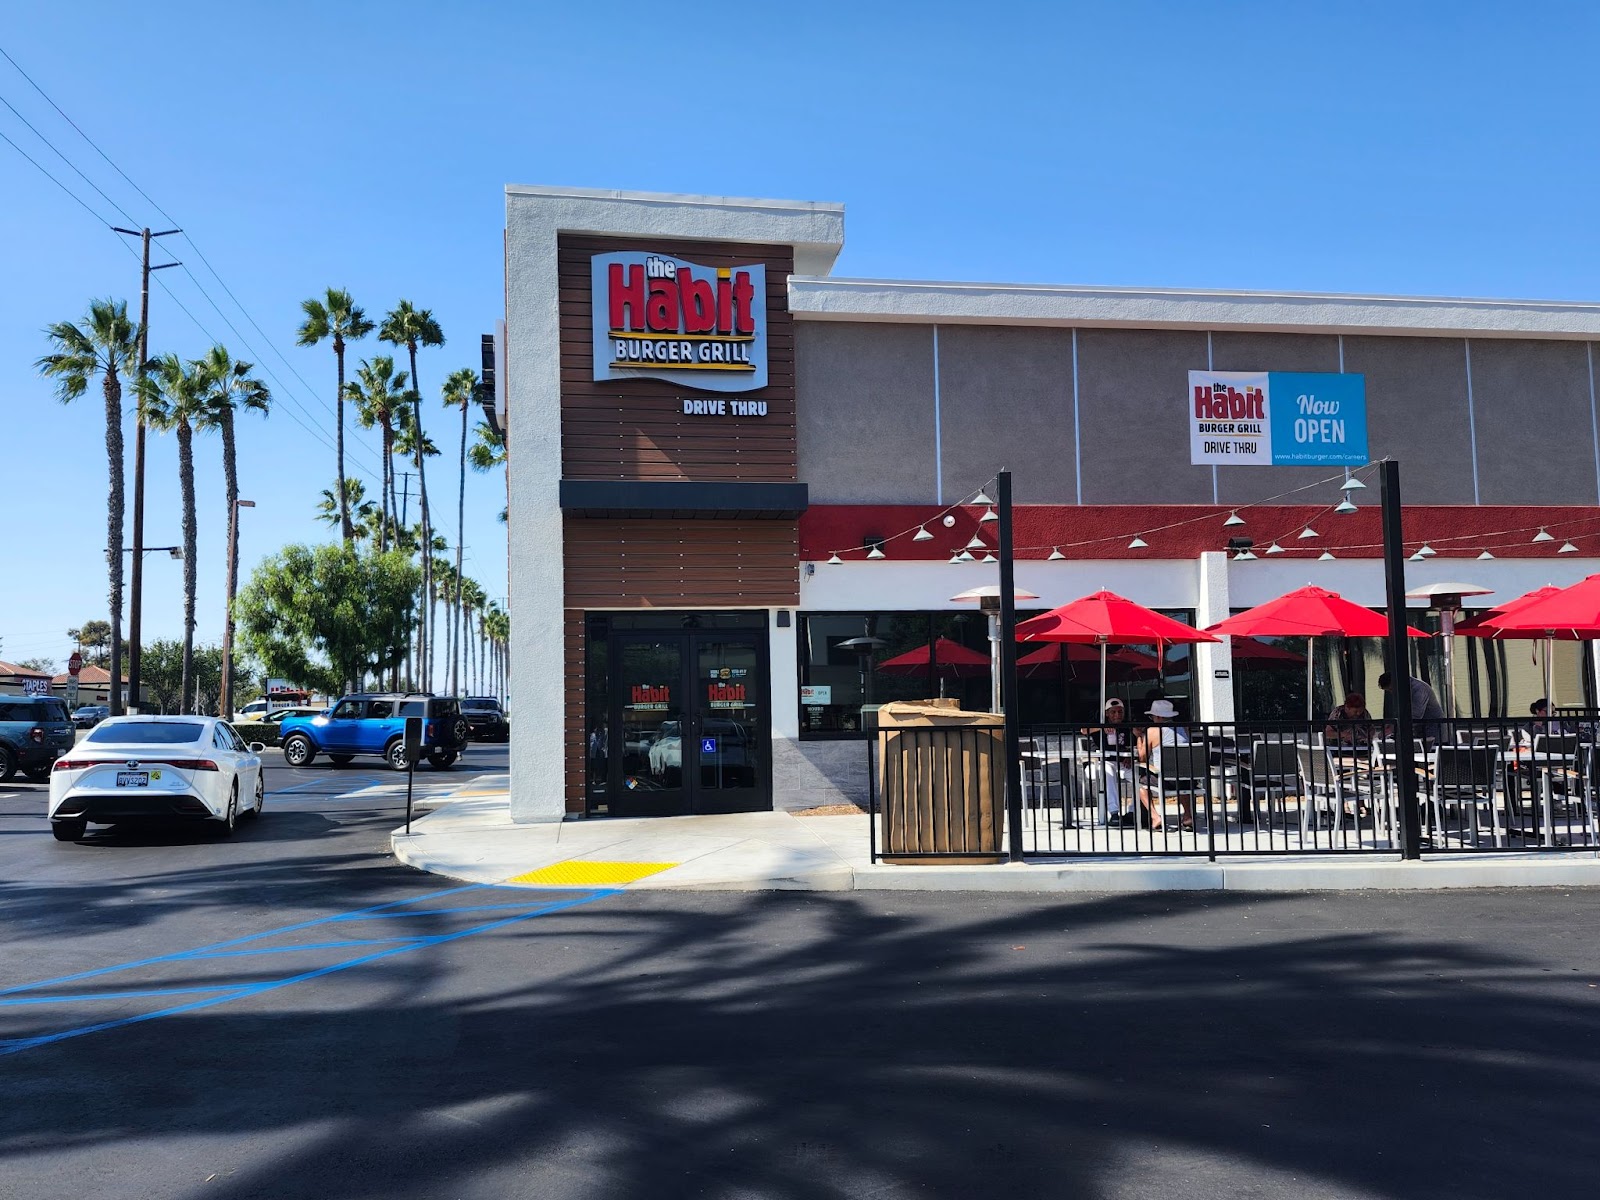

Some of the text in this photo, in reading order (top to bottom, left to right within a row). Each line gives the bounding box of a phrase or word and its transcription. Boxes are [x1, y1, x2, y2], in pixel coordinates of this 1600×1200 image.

[646, 256, 676, 279] the
[608, 263, 756, 334] Habit
[615, 340, 750, 364] BURGER GRILL
[1213, 382, 1227, 393] the
[683, 400, 768, 417] DRIVE THRU
[1194, 386, 1265, 420] Habit
[1296, 394, 1340, 416] Now
[1199, 423, 1262, 434] BURGER GRILL
[1294, 419, 1345, 444] OPEN
[1204, 441, 1257, 454] DRIVE THRU
[1274, 453, 1367, 461] www.habitburger.com/careers
[69, 660, 81, 669] STOP
[631, 684, 670, 702] Habit
[708, 683, 746, 701] Habit
